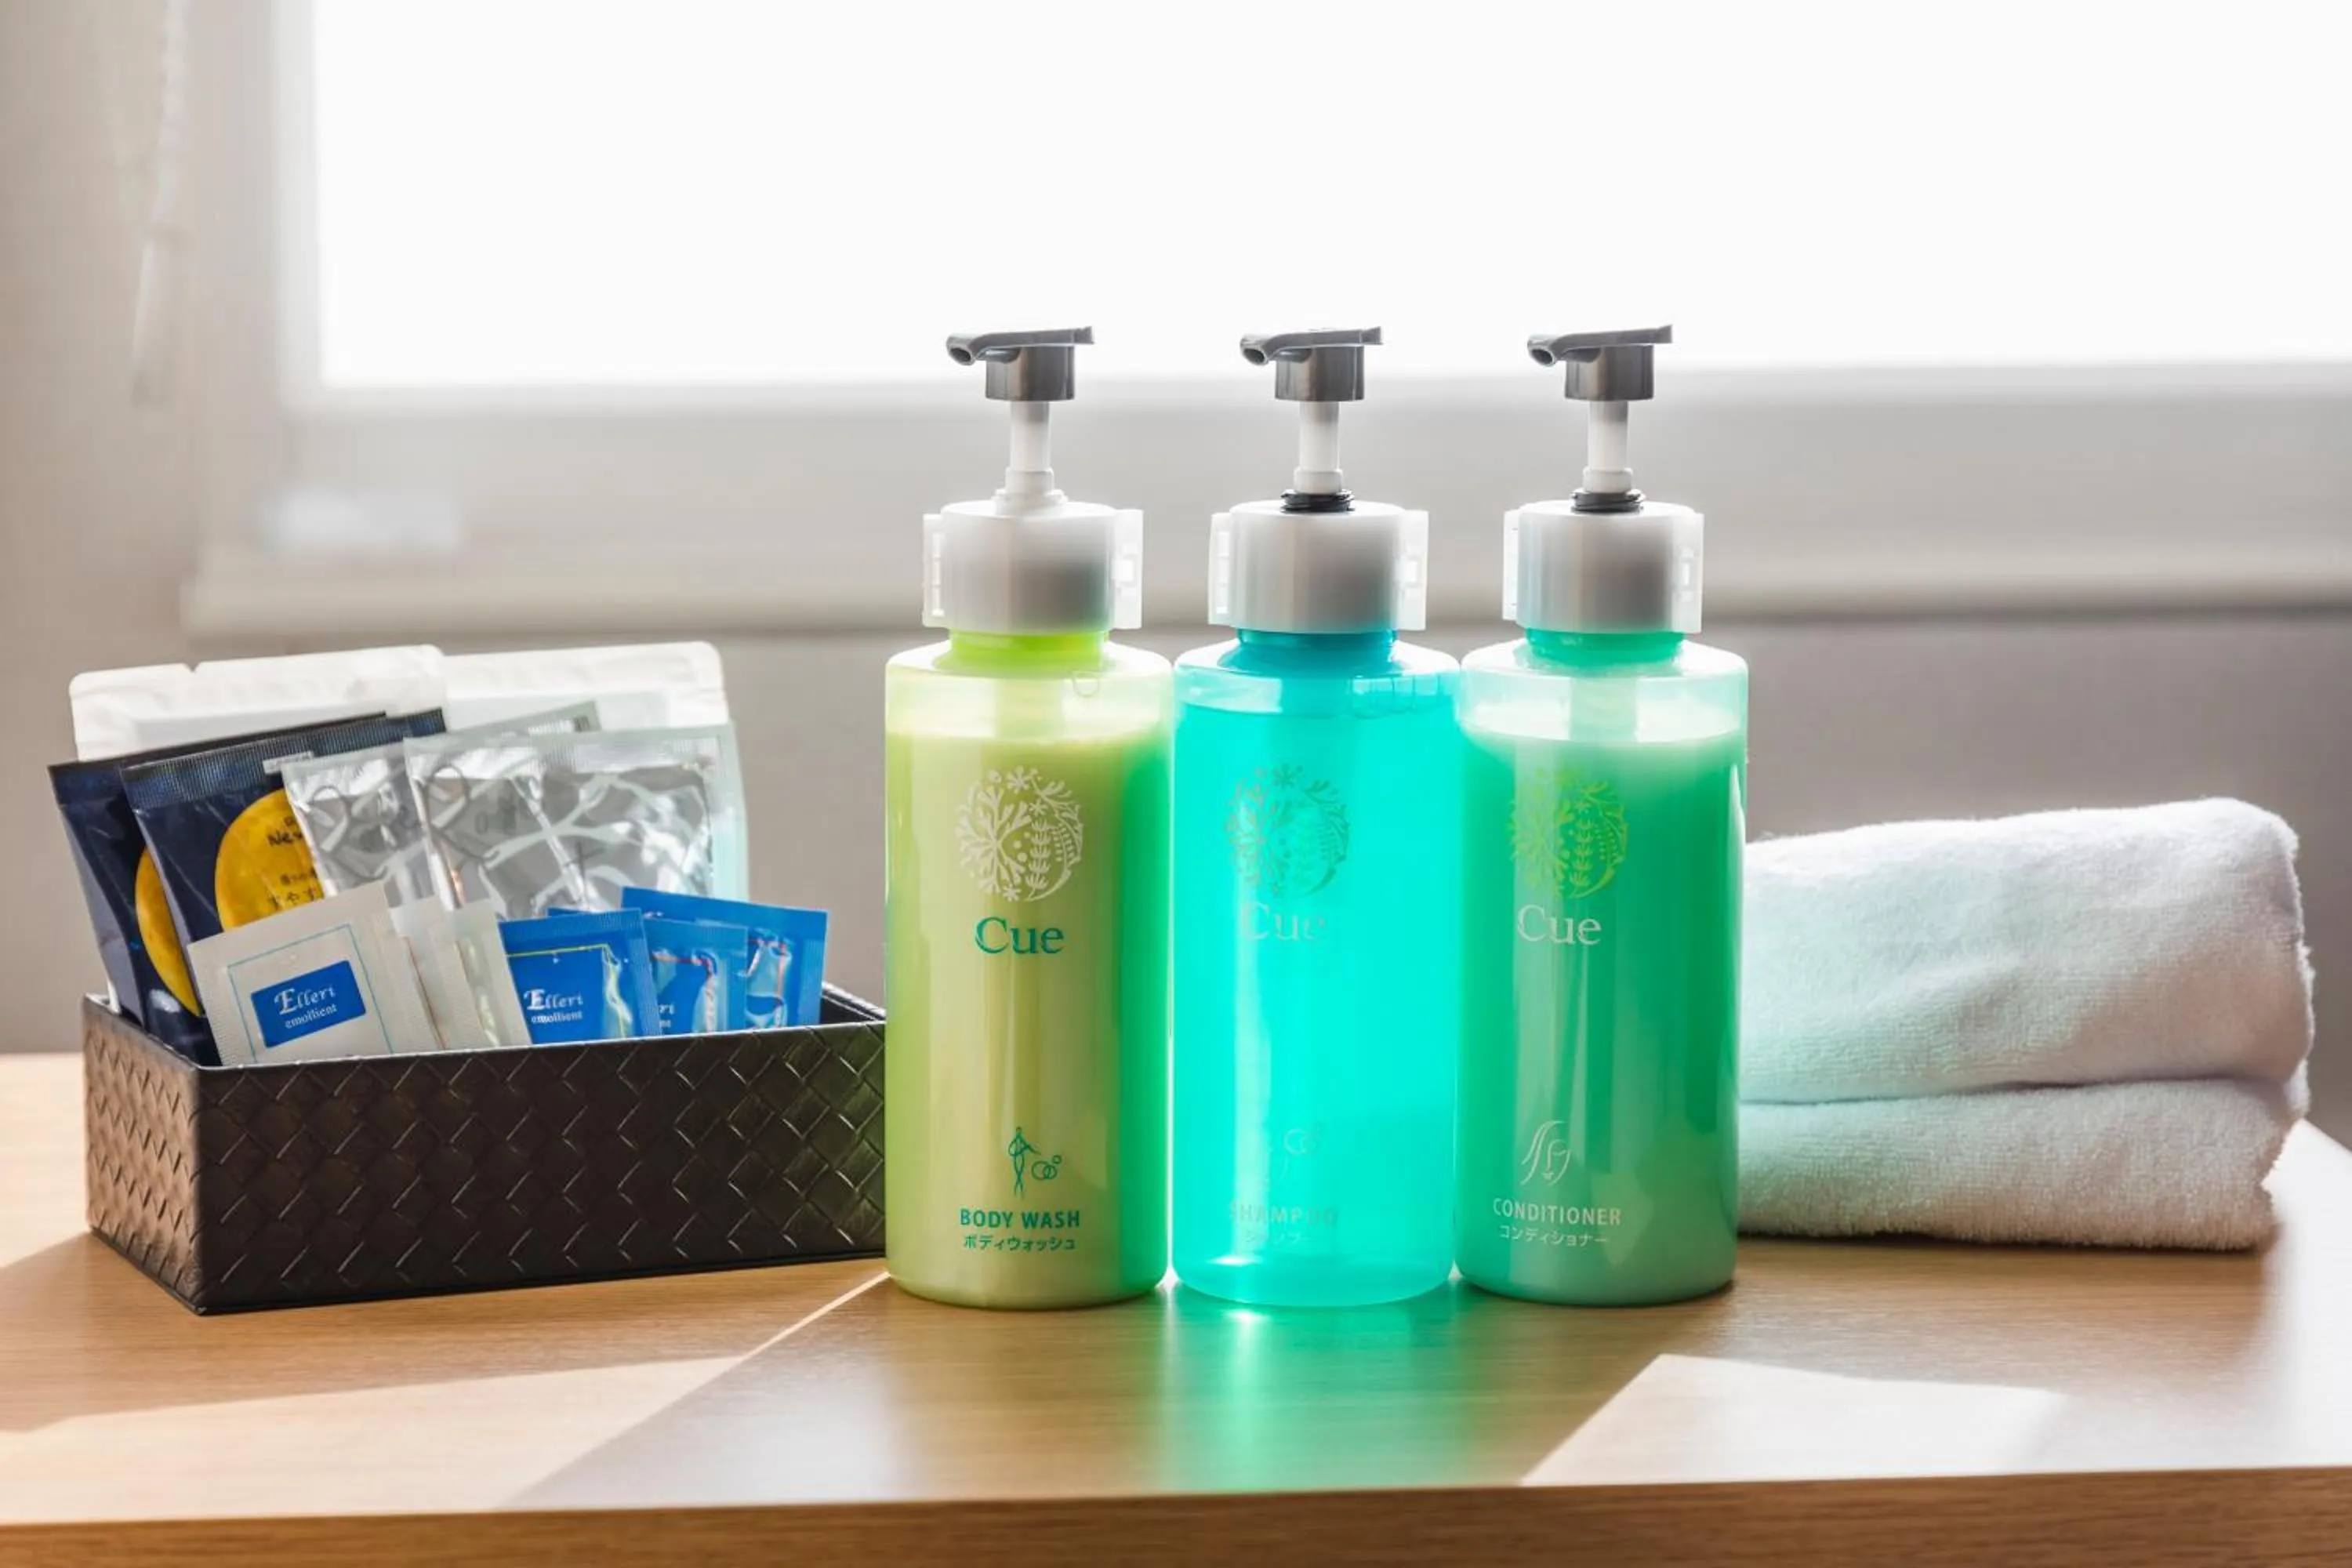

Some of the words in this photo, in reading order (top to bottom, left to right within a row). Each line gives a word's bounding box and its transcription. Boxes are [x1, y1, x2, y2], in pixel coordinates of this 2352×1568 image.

[975, 916, 1065, 954] Cue
[1240, 902, 1328, 941] Cue
[1517, 904, 1602, 946] Cue
[285, 1003, 338, 1029] emollient
[960, 1208, 1013, 1229] BODY
[1022, 1210, 1080, 1229] WASH
[1493, 1198, 1622, 1226] CONDITIONER
[964, 1234, 1076, 1252] ボディウォッシュ
[1499, 1225, 1610, 1247] コンディショナー
